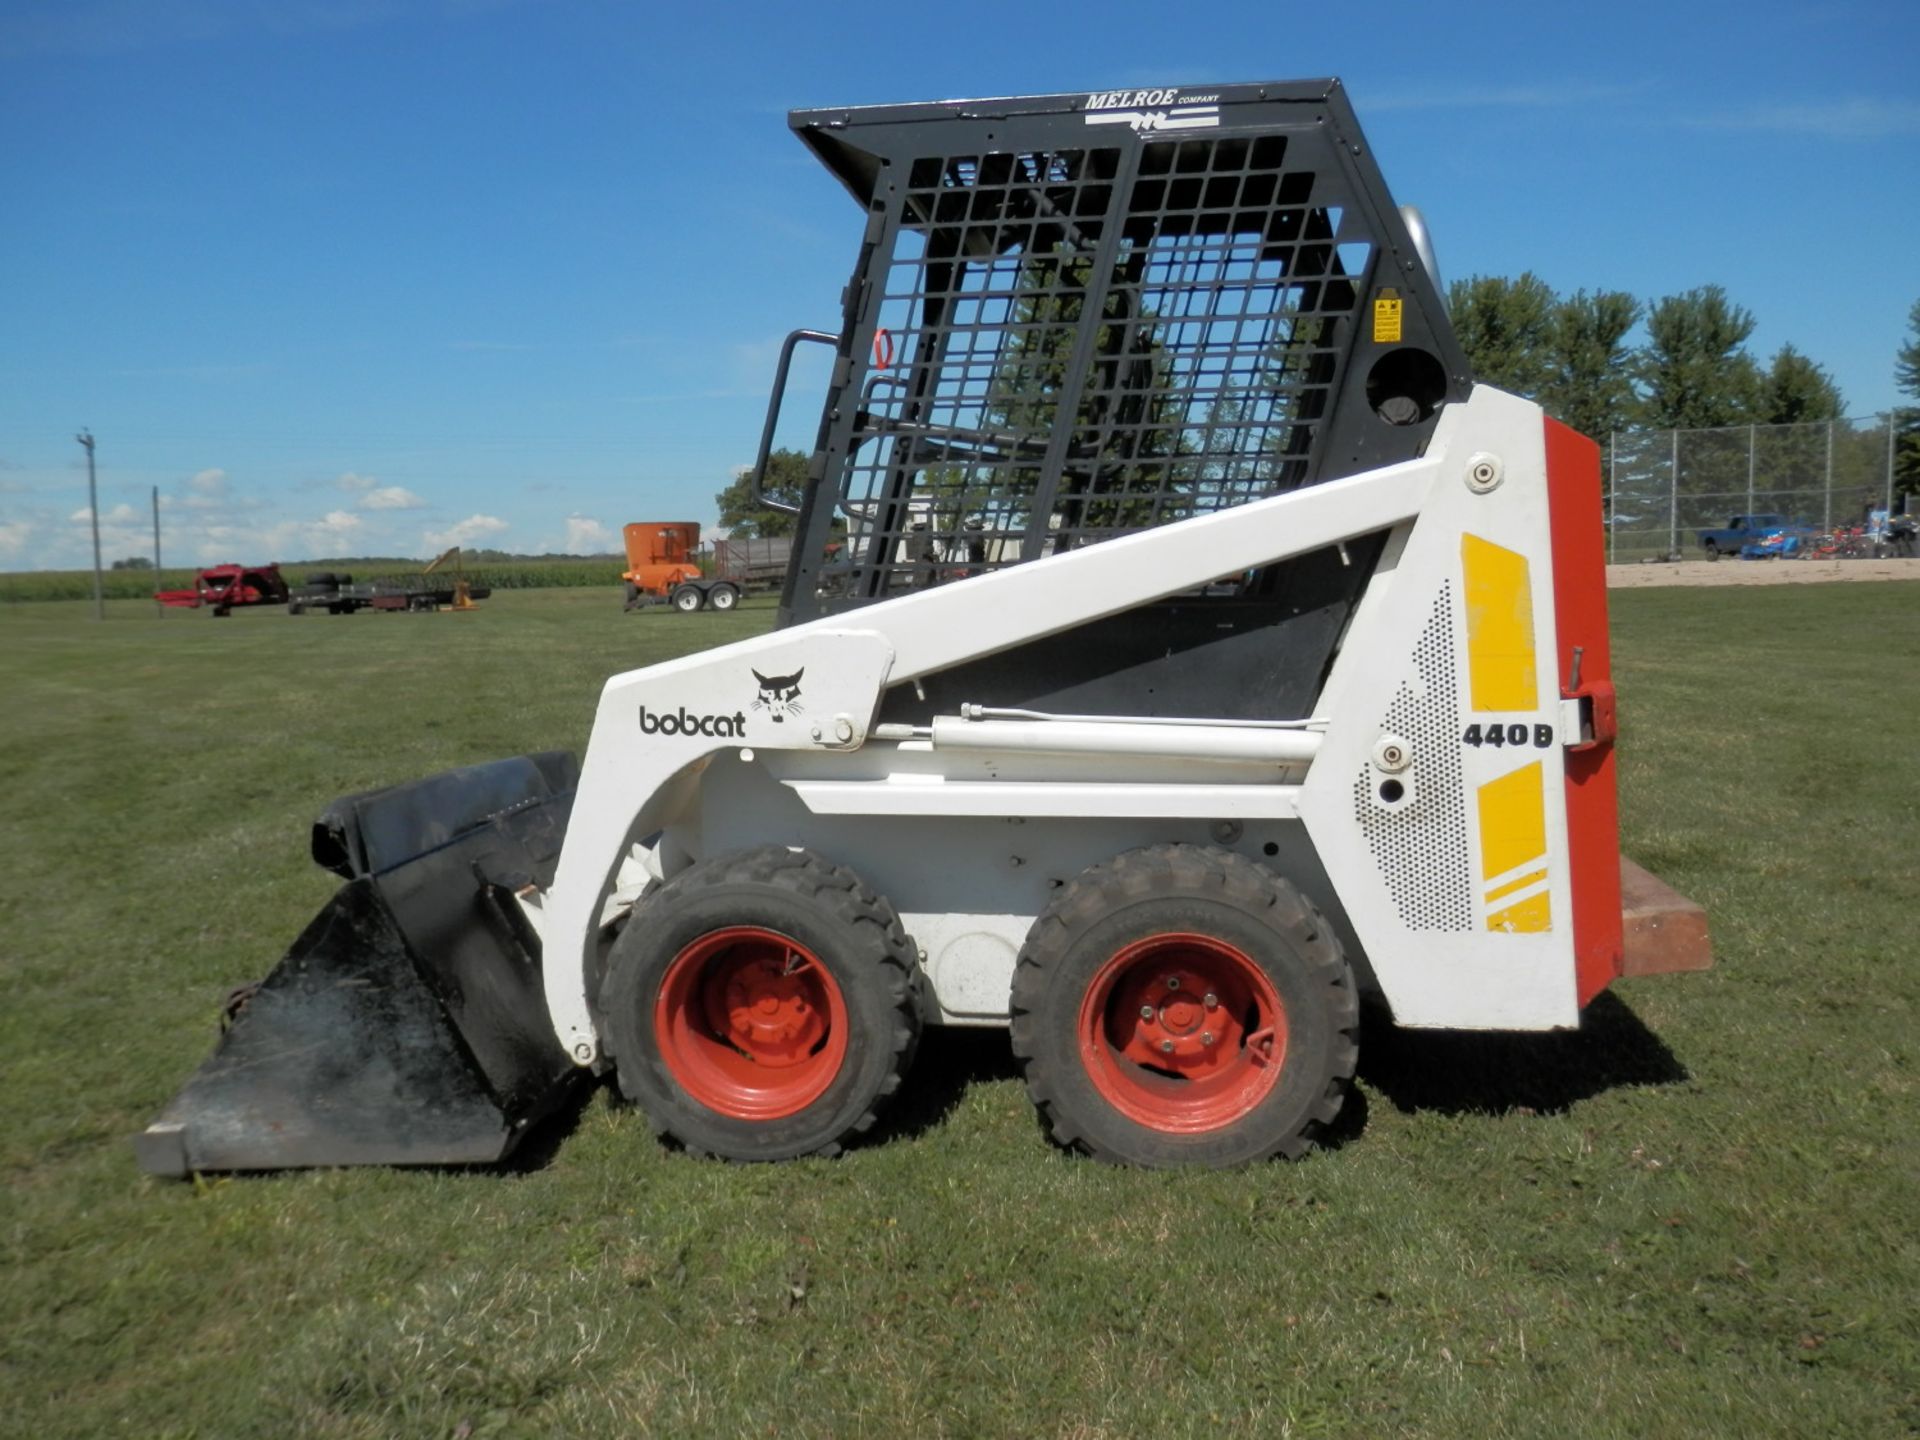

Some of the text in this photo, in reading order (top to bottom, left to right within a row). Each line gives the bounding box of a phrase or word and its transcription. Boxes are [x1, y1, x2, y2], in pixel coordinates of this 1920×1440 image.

[1085, 89, 1220, 110] MELROE COMPANY
[640, 705, 746, 737] bobcat
